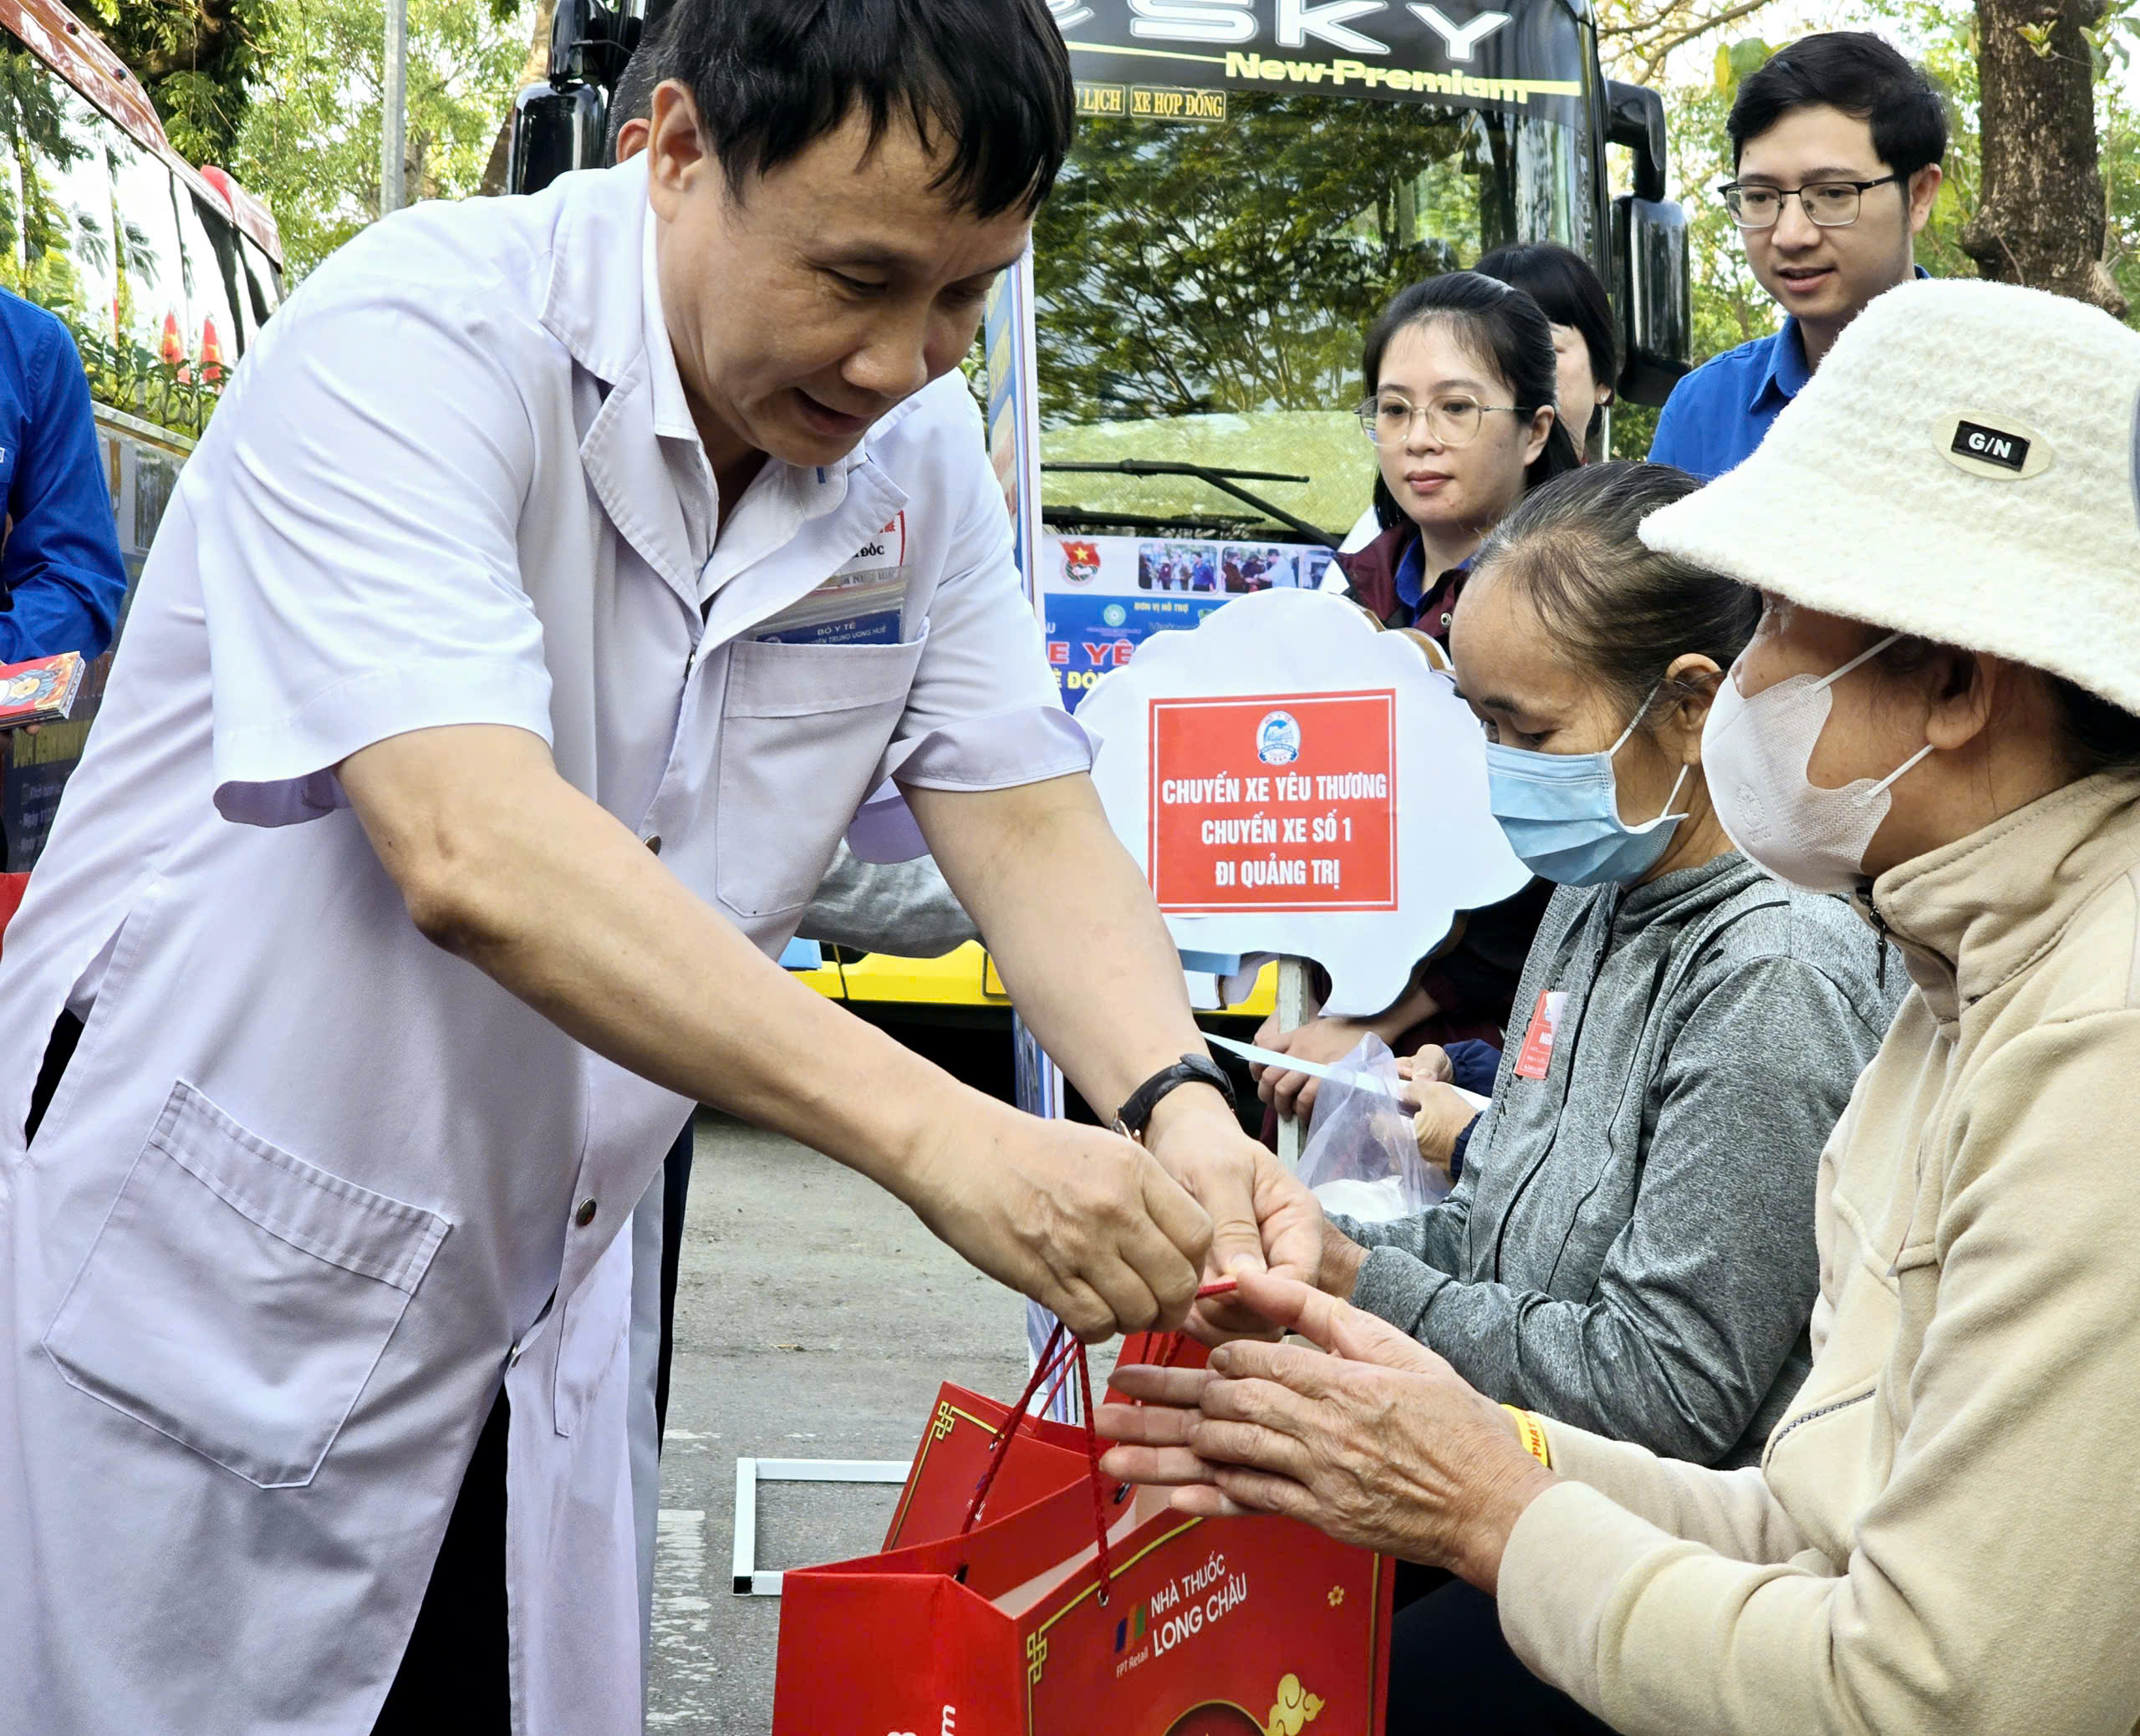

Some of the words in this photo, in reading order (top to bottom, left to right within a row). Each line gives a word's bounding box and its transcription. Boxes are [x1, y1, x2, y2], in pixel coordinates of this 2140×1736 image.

[1332, 59, 1528, 104] Premium
[1083, 88, 1122, 115] LỊCH
[1133, 91, 1151, 114] XE
[1156, 91, 1183, 118] HỢP
[1185, 89, 1223, 118] ĐỒNG
[1968, 432, 2012, 459] G/N
[1081, 639, 1135, 666] YÊ
[1161, 770, 1240, 804] CHUYẾN
[1245, 777, 1270, 802] XE
[1275, 771, 1312, 802] YÊU
[1316, 771, 1388, 800] THƯƠNG
[1201, 811, 1277, 845] CHUYẾN
[1282, 817, 1307, 843] XE
[1312, 808, 1338, 843] SỐ
[1342, 817, 1352, 842] 1
[1215, 861, 1236, 886] ĐI
[1241, 852, 1307, 889] QUẢNG
[1311, 858, 1340, 889] TRỊ
[1150, 1578, 1180, 1618] NHÀ
[1181, 1550, 1225, 1598] THUỐC
[1153, 1605, 1204, 1657] LONG
[1205, 1572, 1247, 1622] CHÂU
[1116, 1659, 1129, 1678] FPT
[1129, 1646, 1149, 1670] Retail
